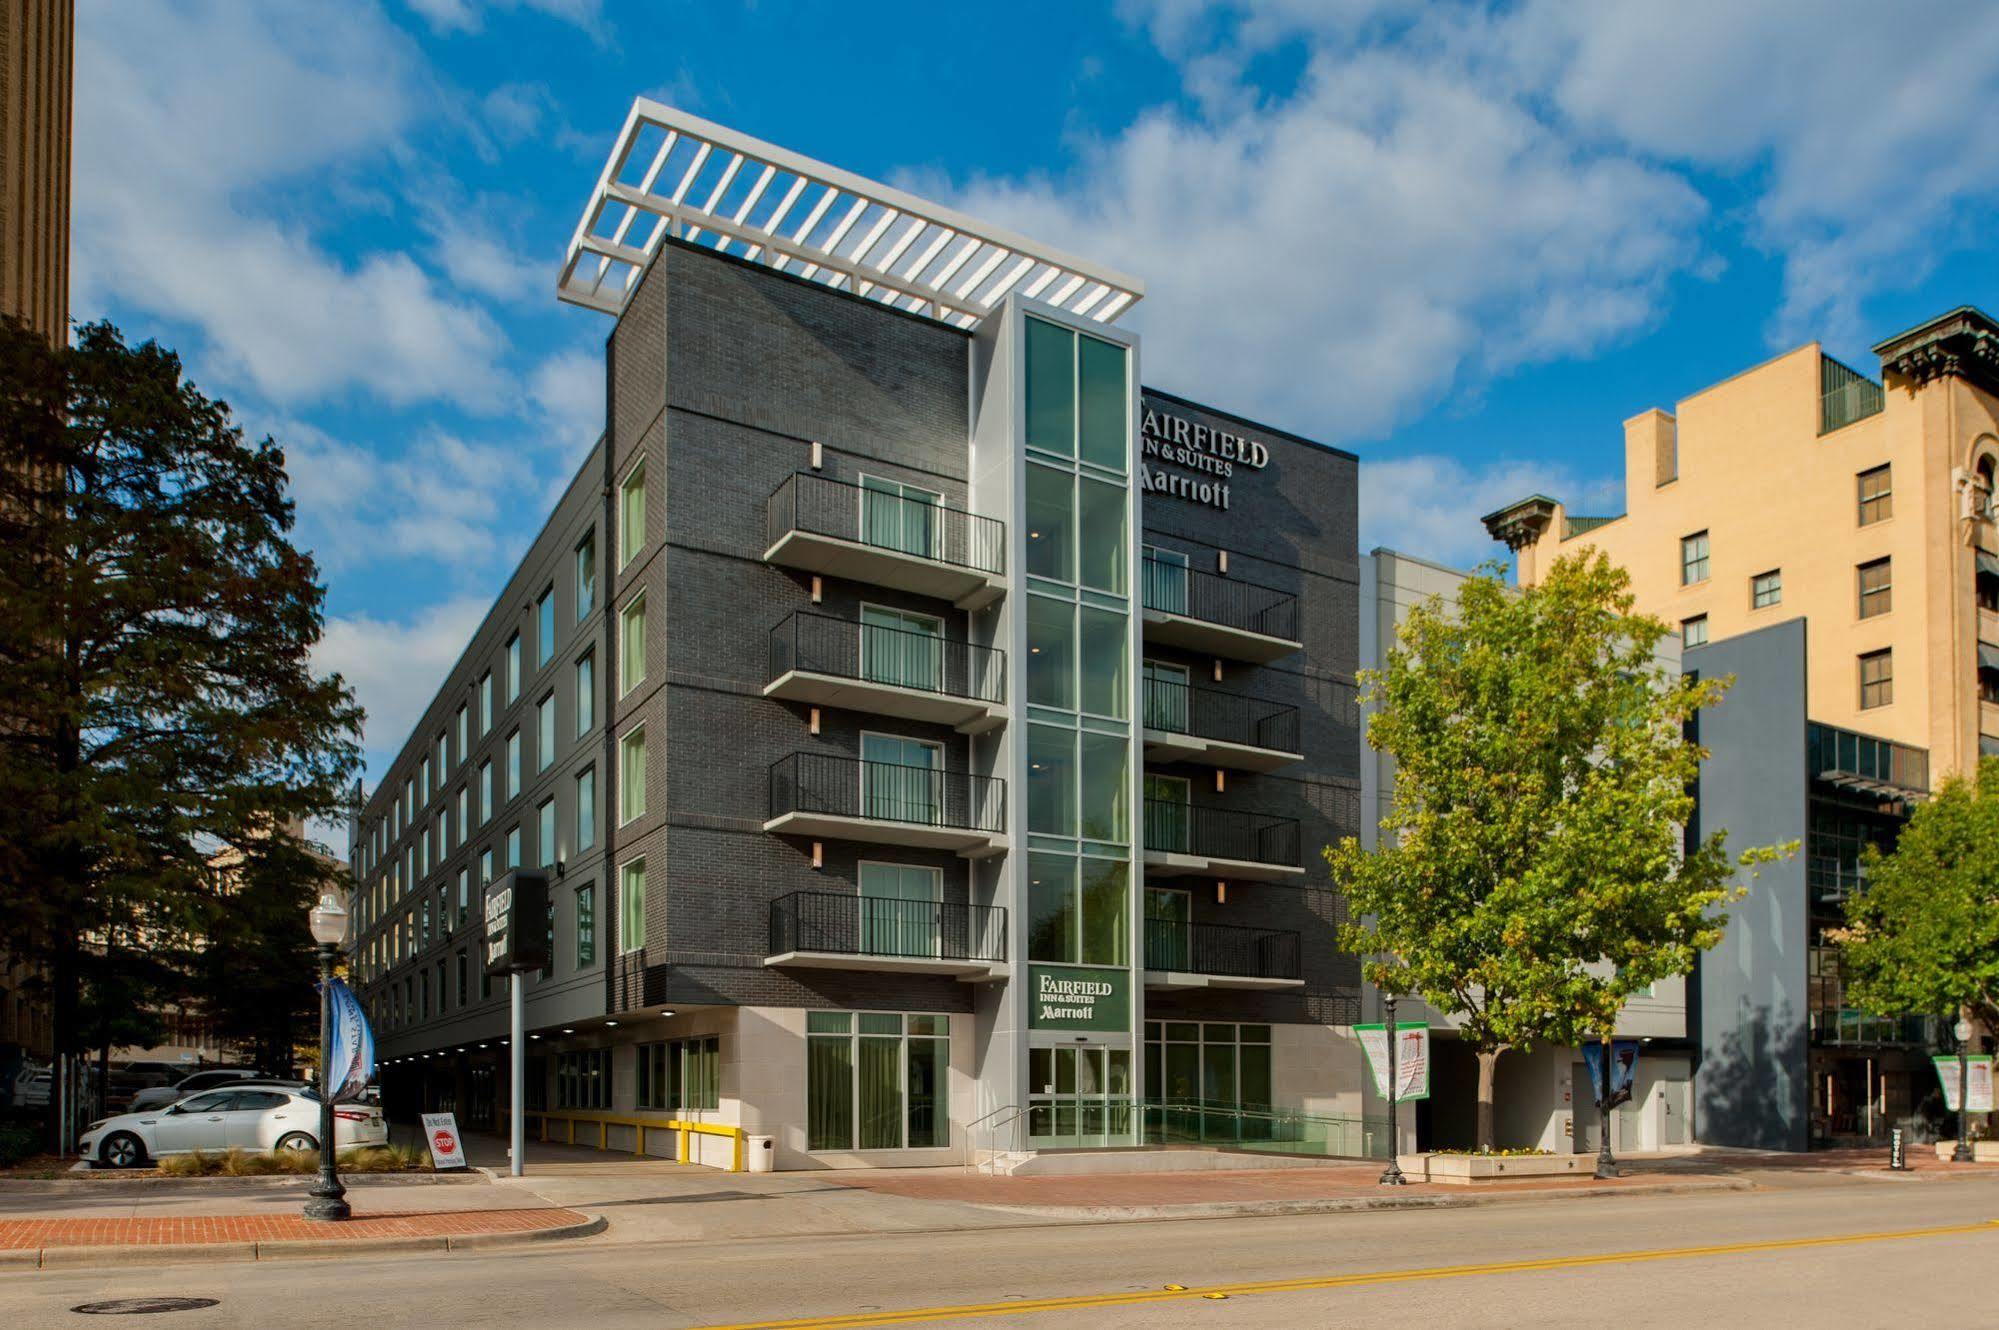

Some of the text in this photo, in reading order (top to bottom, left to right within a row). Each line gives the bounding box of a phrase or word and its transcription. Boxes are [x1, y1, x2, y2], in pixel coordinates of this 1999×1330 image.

[1141, 398, 1269, 470] AIRFIELD
[1176, 448, 1233, 478] SUITES
[1039, 975, 1113, 996] FAIRFIELD
[1039, 993, 1058, 1003] INN
[1065, 994, 1095, 1005] SUITES
[1039, 1004, 1093, 1020] Marriott
[435, 1137, 454, 1148] STOP
